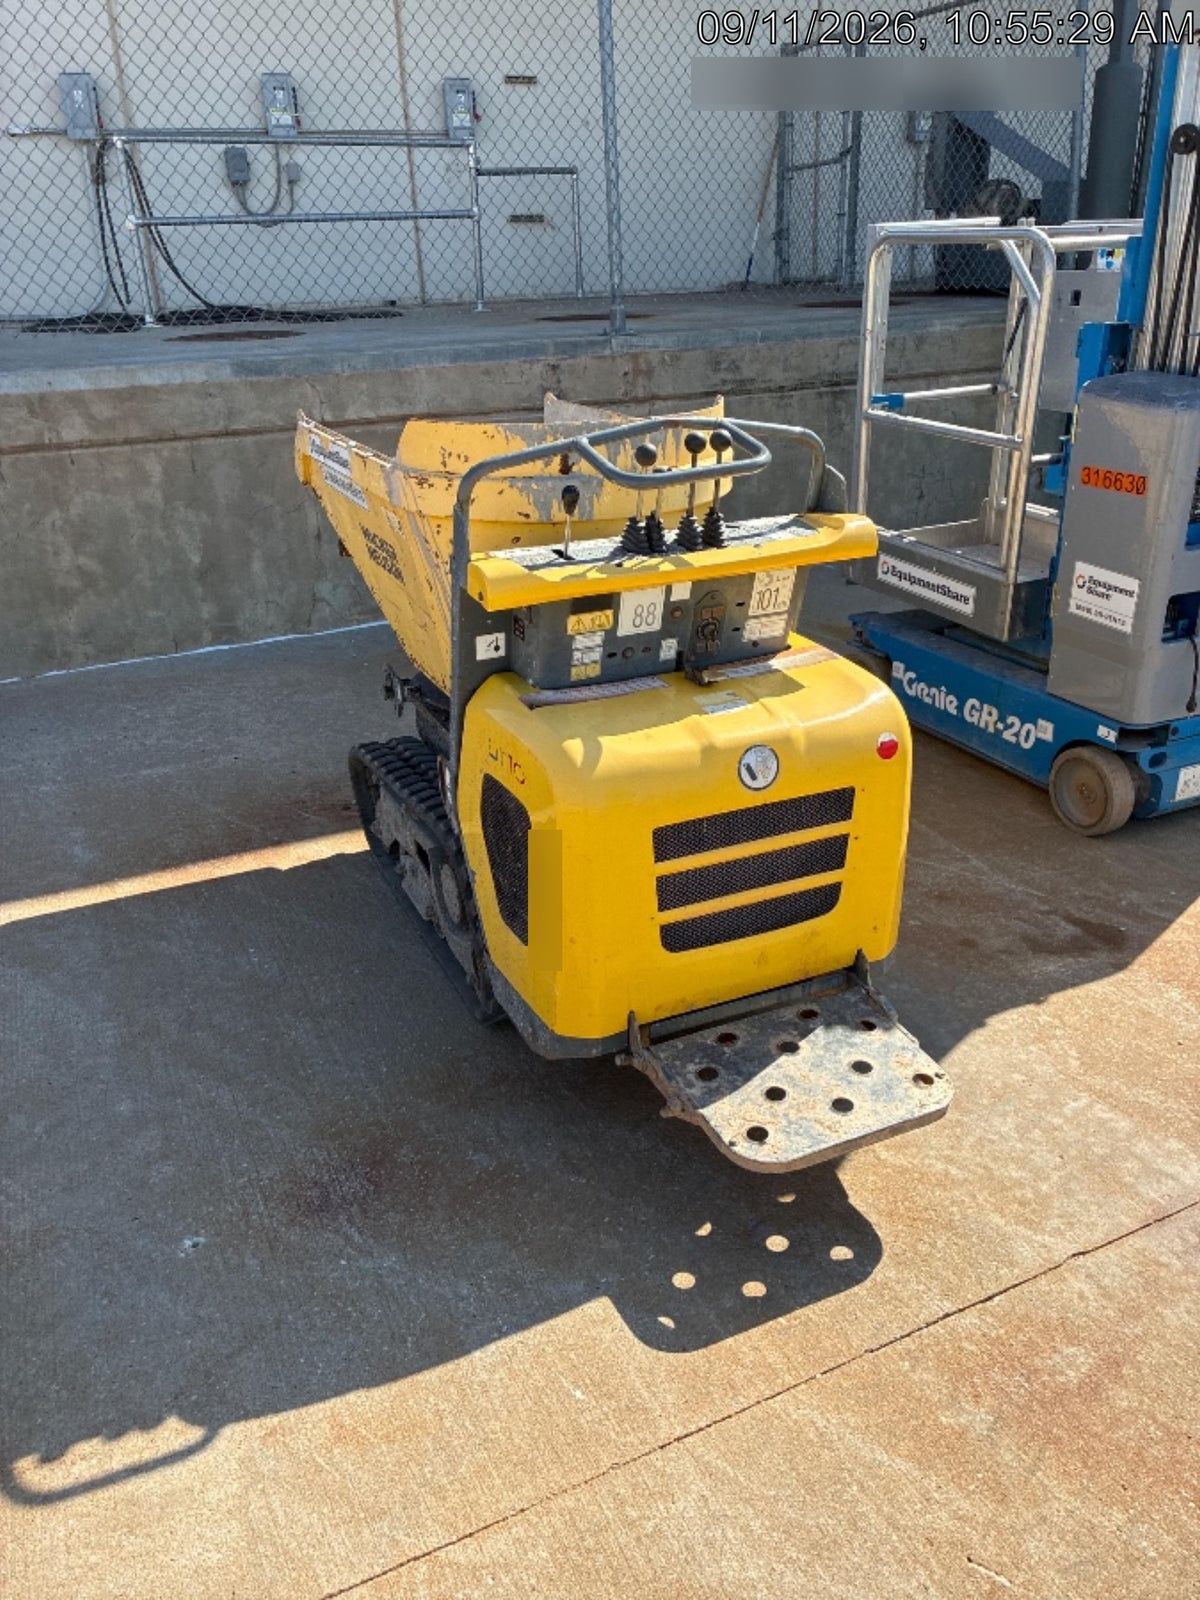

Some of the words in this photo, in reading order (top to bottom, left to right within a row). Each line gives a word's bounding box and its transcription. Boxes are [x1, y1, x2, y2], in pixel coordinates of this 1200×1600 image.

[1081, 466, 1147, 495] 316630
[890, 564, 970, 606] EquipmentShare
[1086, 586, 1112, 602] Share
[1087, 575, 1136, 598] Equipment
[756, 587, 780, 610] 101
[632, 602, 657, 628] 88
[903, 671, 959, 716] Genie
[963, 698, 1036, 750] GR-20
